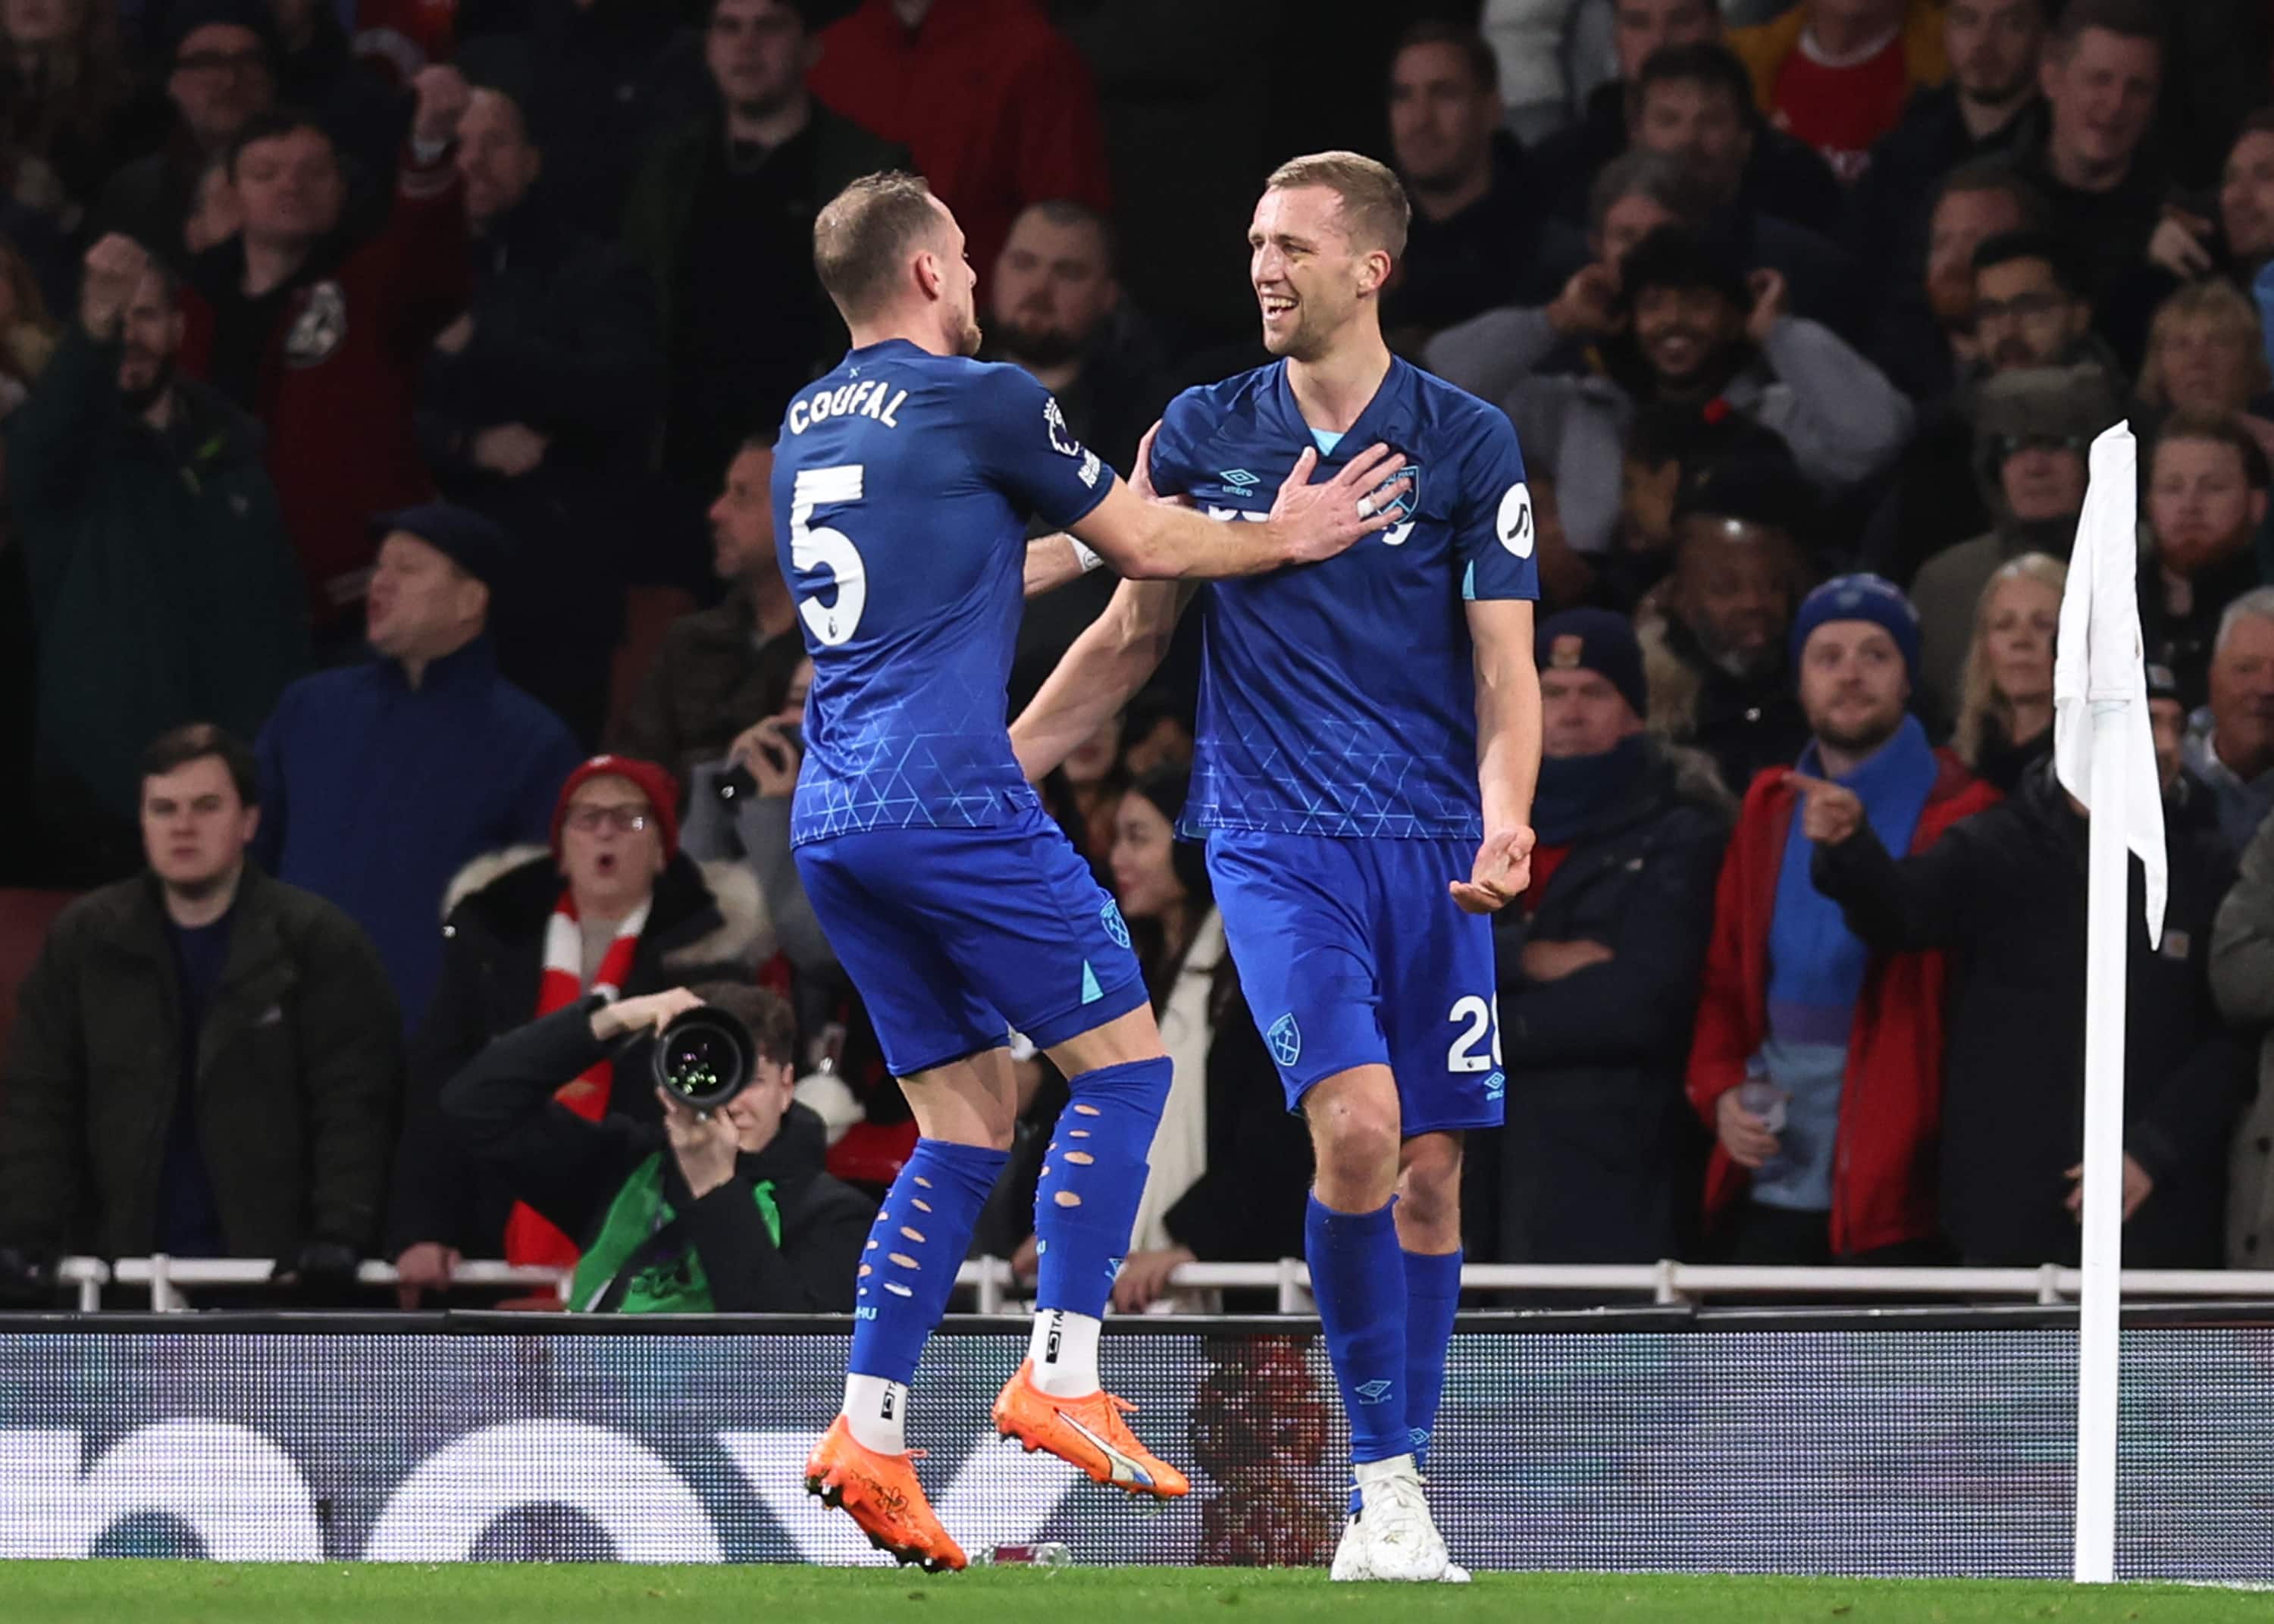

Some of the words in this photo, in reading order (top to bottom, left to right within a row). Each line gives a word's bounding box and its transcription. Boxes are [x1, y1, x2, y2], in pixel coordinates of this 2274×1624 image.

[789, 380, 908, 436] COUFAL
[789, 464, 866, 647] 5
[1448, 990, 1503, 1072] 2
